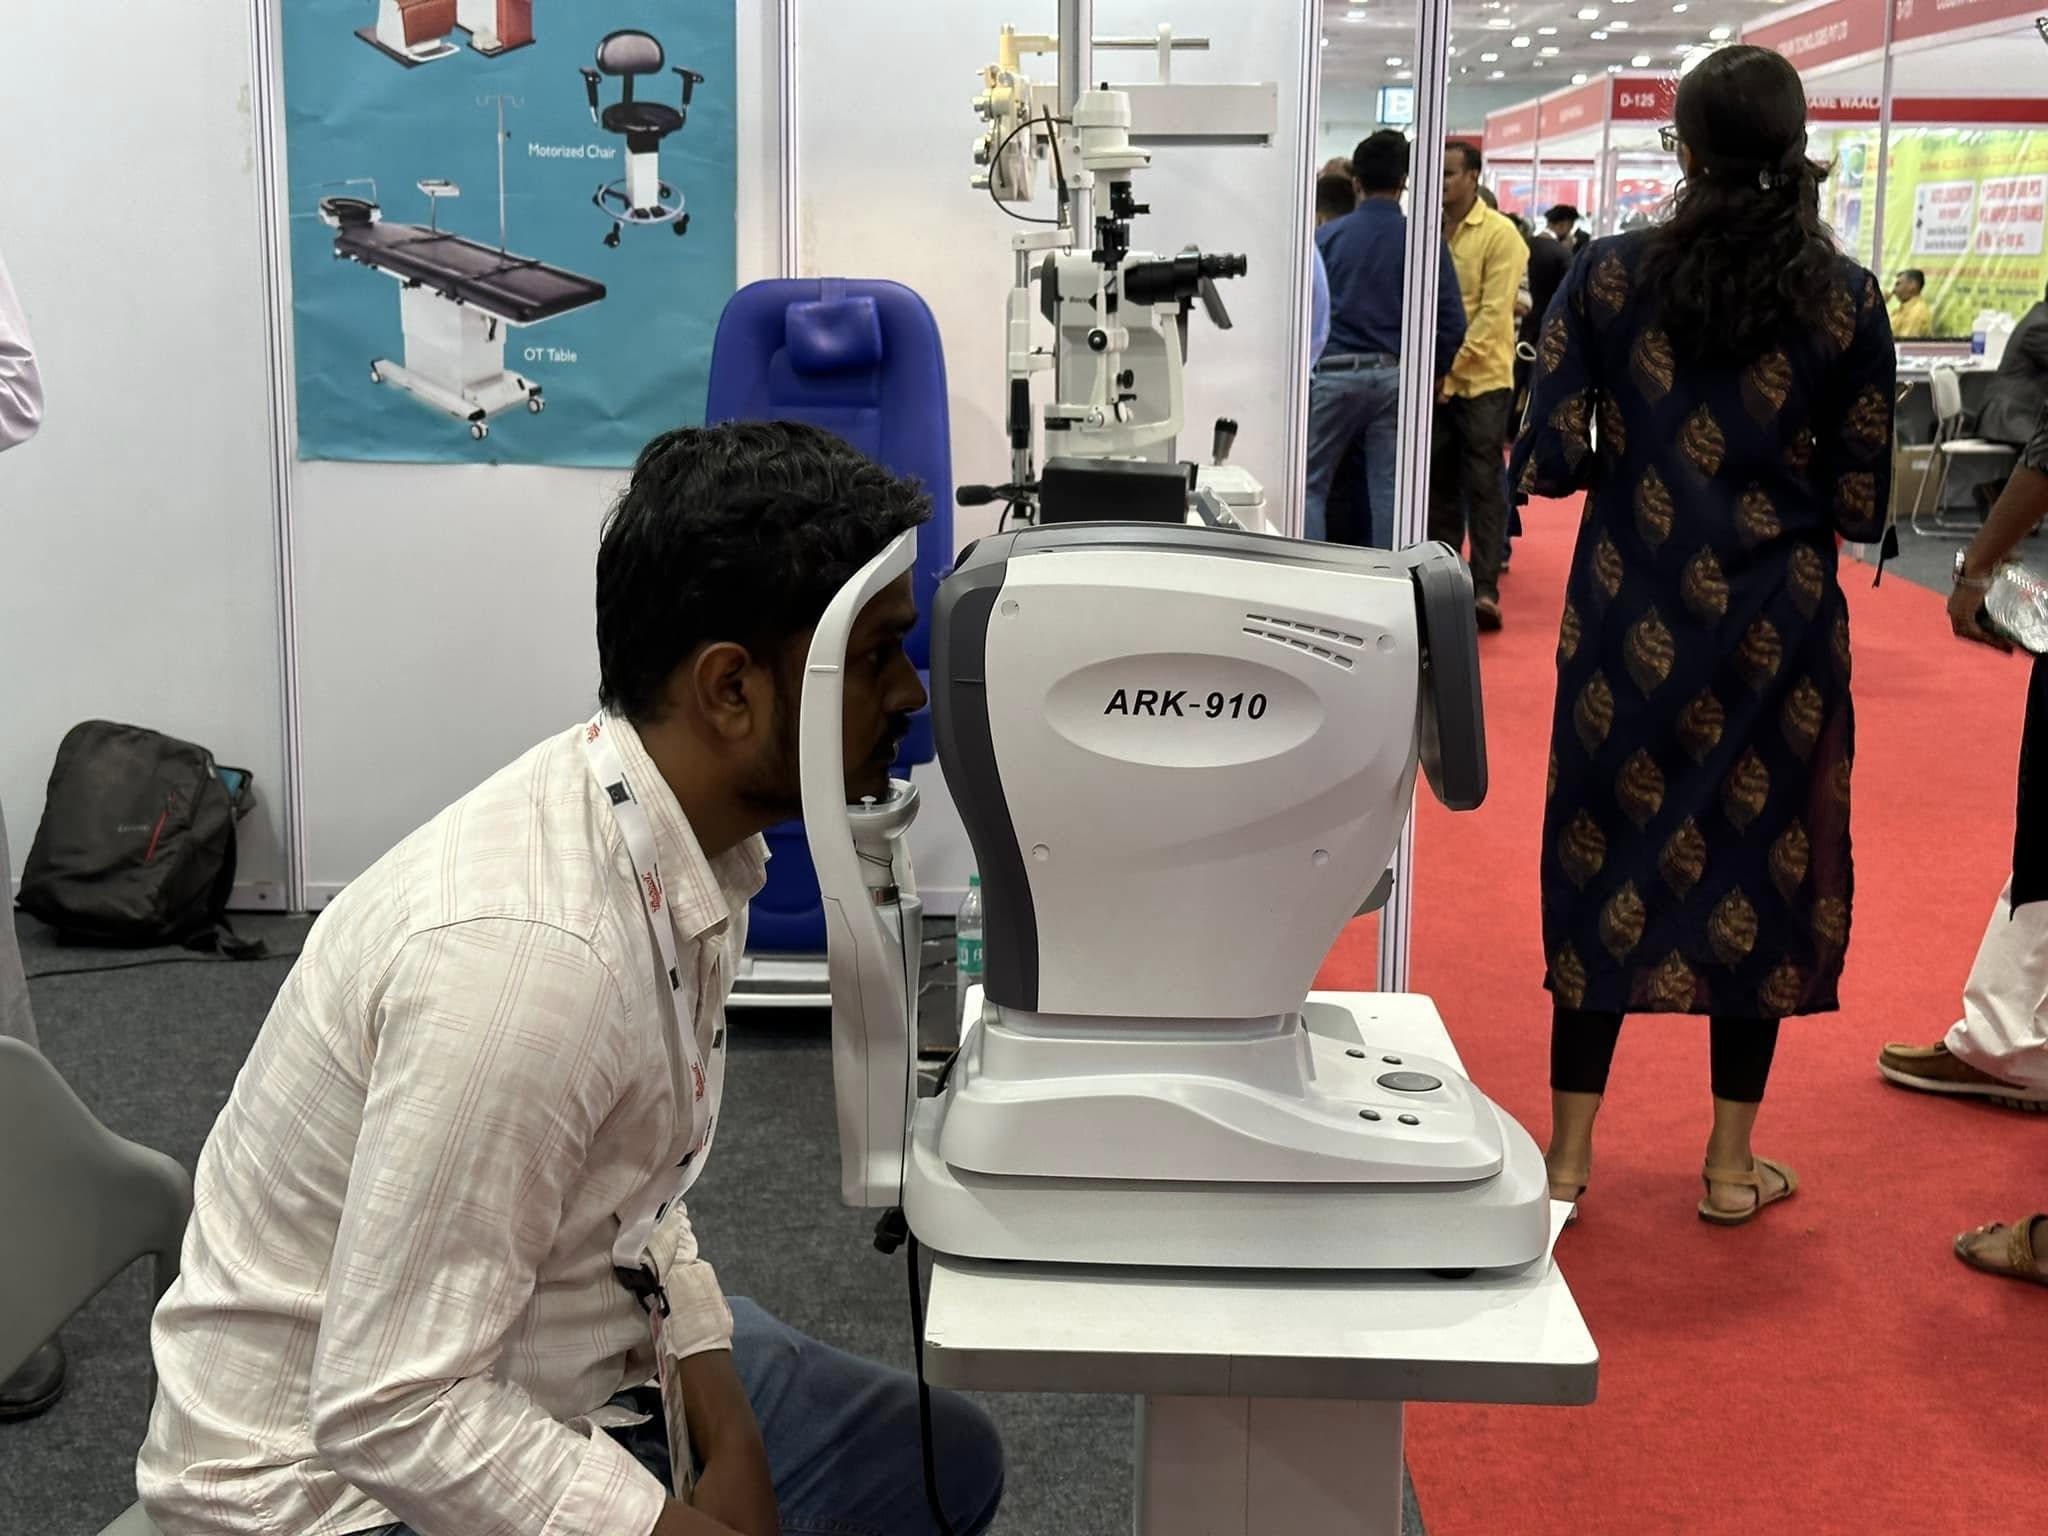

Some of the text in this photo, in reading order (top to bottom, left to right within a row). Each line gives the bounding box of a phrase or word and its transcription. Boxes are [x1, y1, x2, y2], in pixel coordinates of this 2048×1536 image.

[1620, 92, 1655, 107] D-125
[1806, 96, 1837, 109] AME
[528, 142, 616, 159] Motorized Chair
[524, 347, 577, 363] OT Table
[1103, 688, 1267, 720] ARK-910
